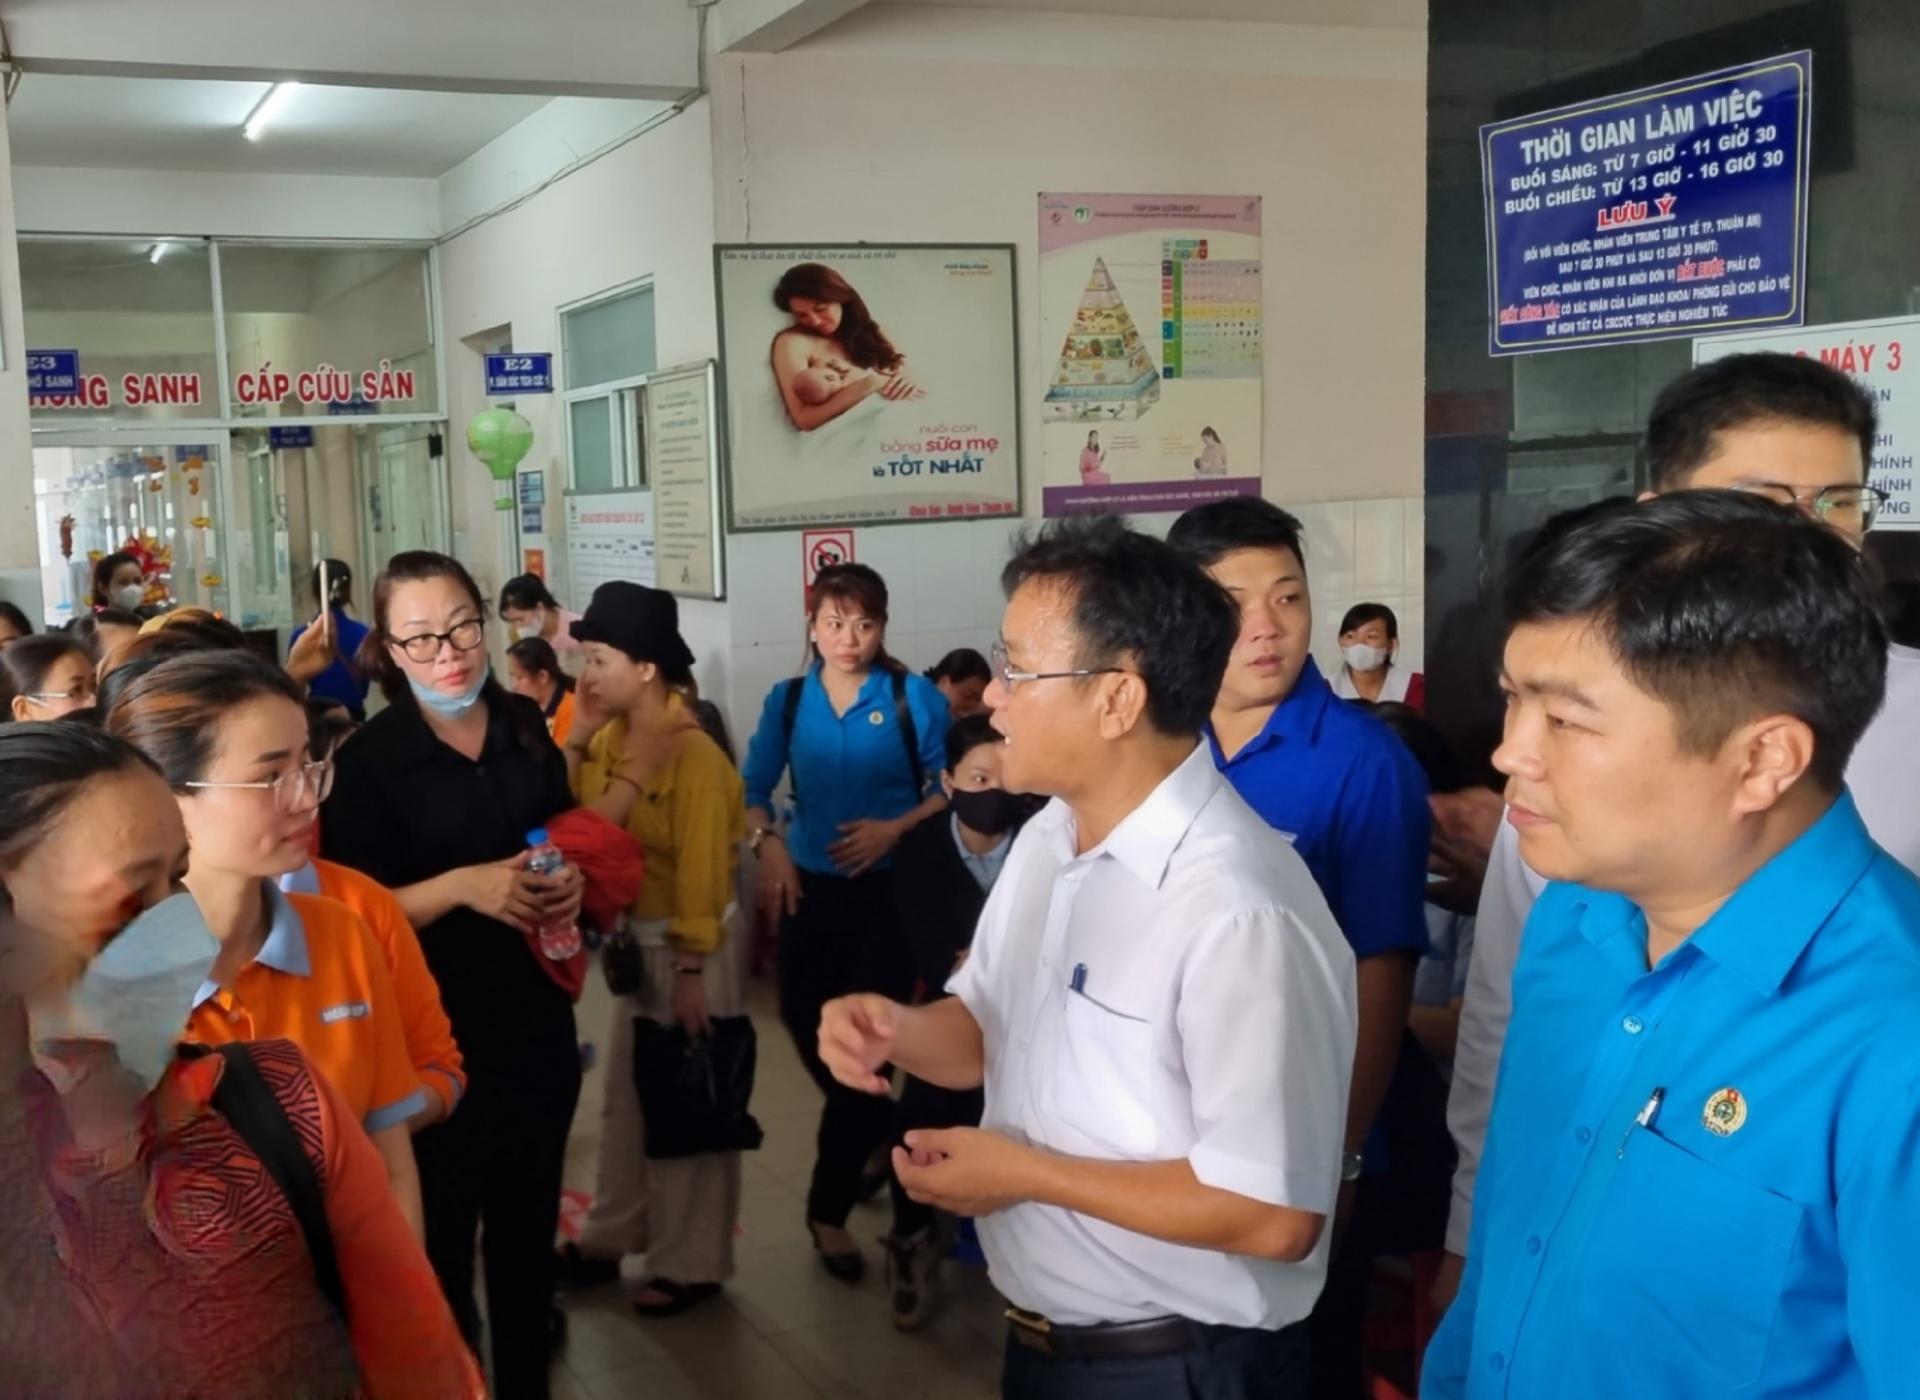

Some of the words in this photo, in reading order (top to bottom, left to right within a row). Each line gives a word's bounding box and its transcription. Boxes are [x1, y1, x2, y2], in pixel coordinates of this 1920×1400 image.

[1521, 127, 1571, 165] THỜI
[1580, 118, 1635, 153] GIAN
[1646, 104, 1694, 140] LÀM
[1703, 88, 1763, 130] VIỆC
[1511, 168, 1546, 192] BUỔI
[1552, 162, 1597, 184] SÁNG:
[1603, 153, 1625, 174] TỪ
[1631, 155, 1640, 170] 7
[1646, 145, 1675, 166] GIỜ
[1693, 139, 1711, 157] 11
[1719, 128, 1750, 152] GIỜ
[1756, 126, 1776, 145] 30
[1505, 192, 1541, 215] BUỔI
[1546, 183, 1596, 208] CHIỀU:
[1602, 178, 1624, 198] TỪ
[1629, 176, 1647, 192] 13
[1652, 165, 1682, 188] GIỜ
[1700, 161, 1719, 179] 16
[1725, 152, 1756, 175] GIỜ
[1763, 150, 1784, 169] 30
[1598, 201, 1647, 227] LƯU
[1635, 229, 1660, 243] TRUNG
[1638, 250, 1654, 262] SAU
[1656, 248, 1665, 260] 13
[1683, 244, 1693, 256] 30
[1726, 255, 1746, 272] PHẢI
[1692, 284, 1719, 300] PHÒNG
[1738, 280, 1756, 295] CHO
[1711, 302, 1729, 318] TÚC
[504, 358, 534, 371] E2
[1820, 339, 1876, 373] MÁY
[1887, 341, 1902, 372] 3
[45, 374, 74, 388] SANH
[124, 374, 200, 404] SANH
[237, 361, 290, 403] CẤP
[297, 364, 351, 403] CỨU
[362, 359, 415, 401] SẢN
[919, 424, 949, 434] nuôi
[951, 424, 977, 434] con
[926, 436, 962, 453] sữa
[967, 437, 1000, 453] mẹ
[888, 454, 924, 477] TỐT
[930, 451, 985, 475] NHẤT
[1872, 454, 1912, 470] HÍNH
[1872, 475, 1912, 491] HÍNH
